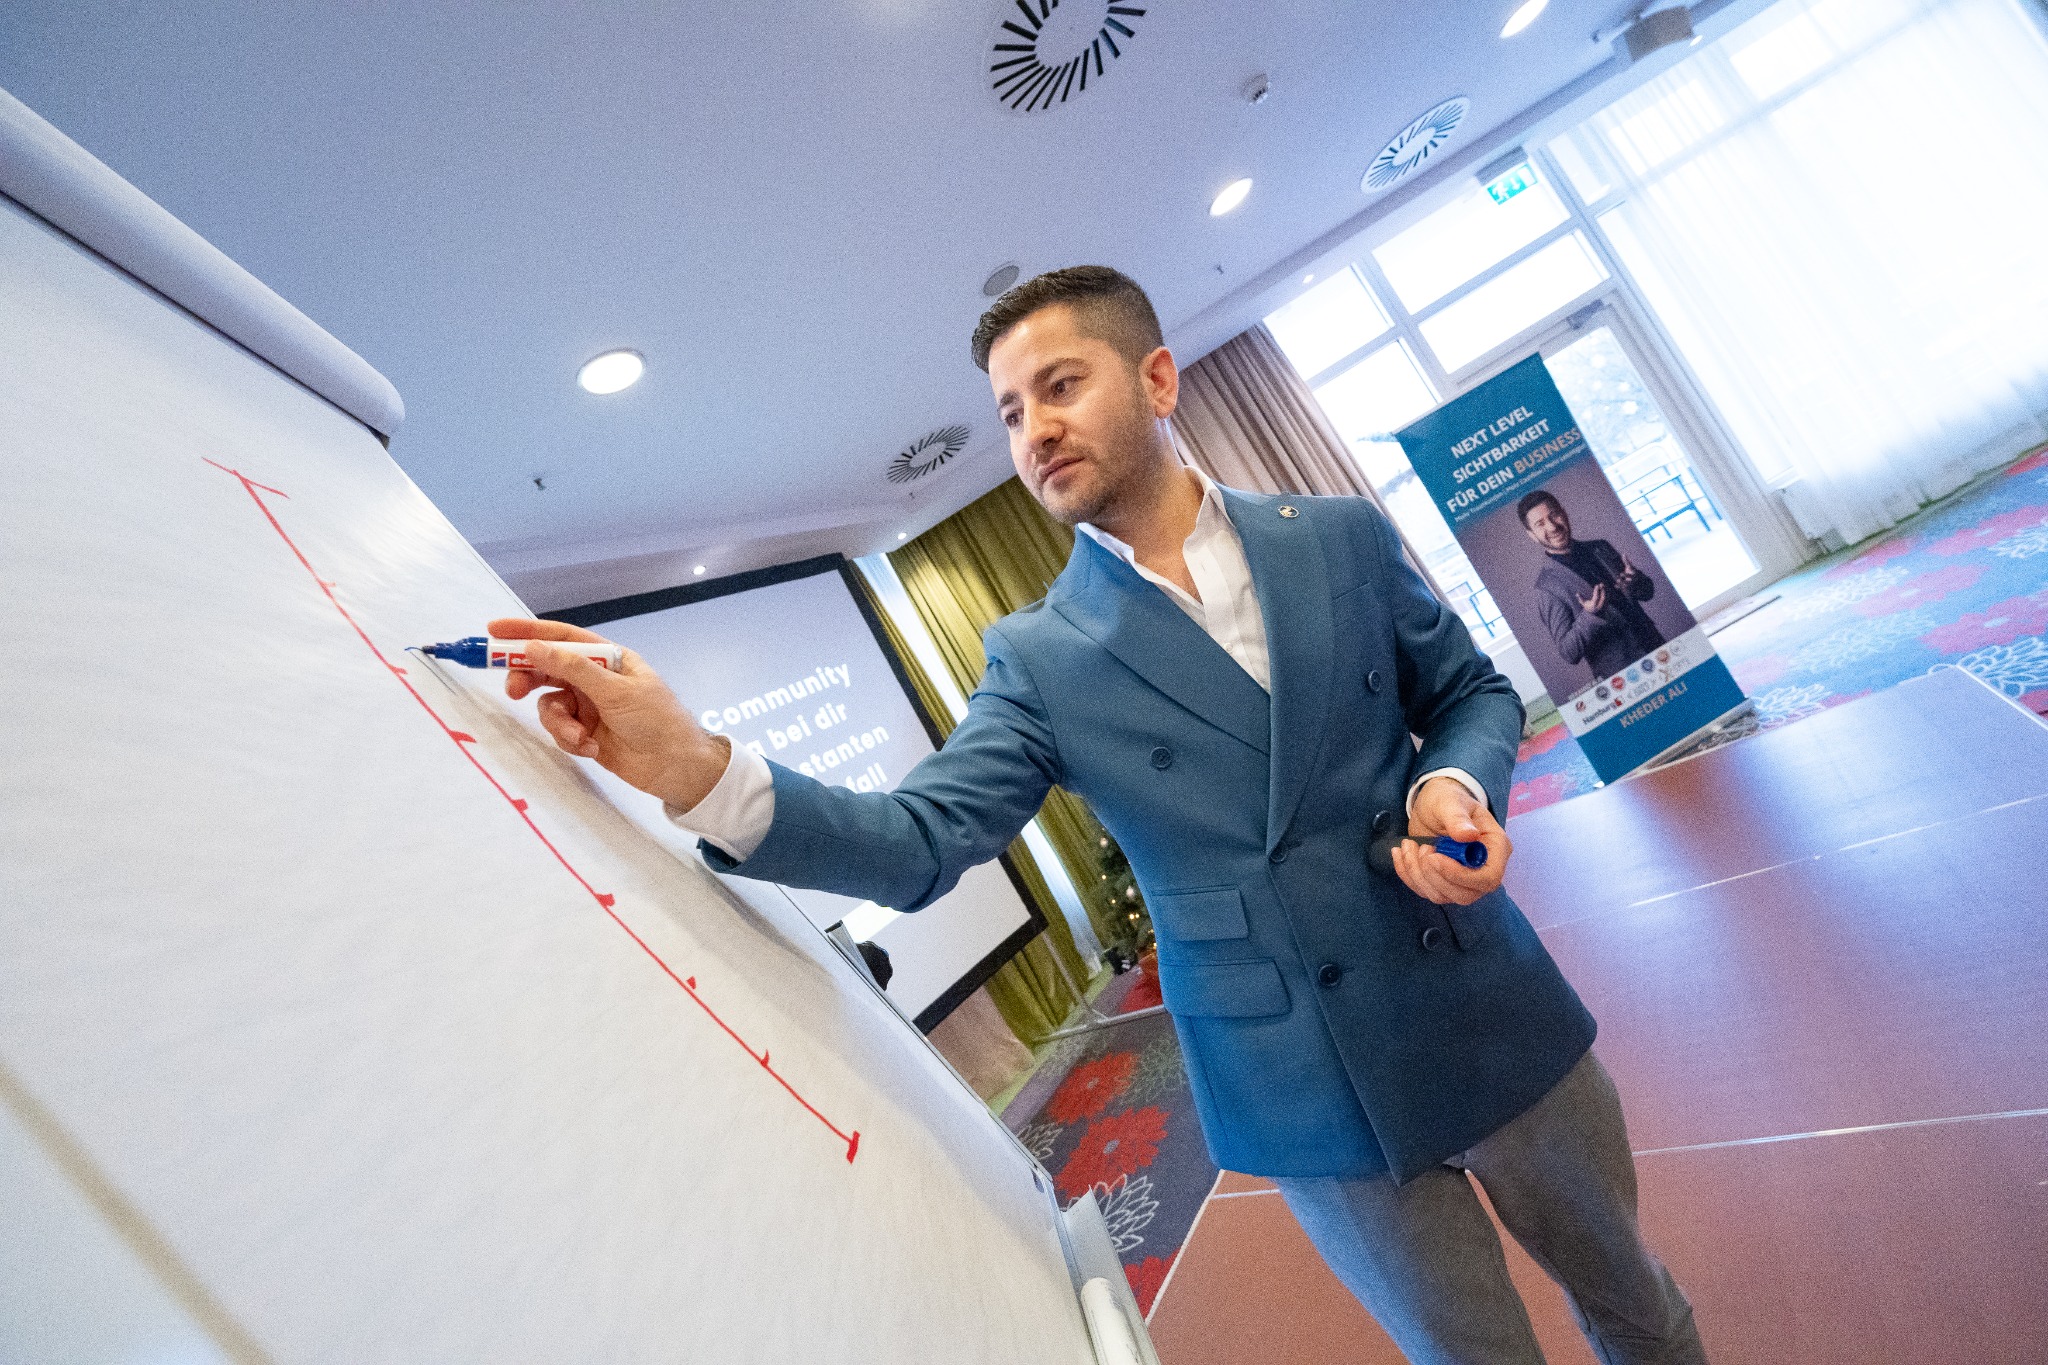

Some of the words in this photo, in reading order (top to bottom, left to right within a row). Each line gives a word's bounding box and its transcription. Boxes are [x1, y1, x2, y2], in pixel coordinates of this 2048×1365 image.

[1451, 430, 1489, 458] NEXT
[1489, 406, 1533, 436] LEVEL
[1453, 419, 1550, 484] SICHTBARKEIT
[1447, 489, 1478, 513] FÜR
[1477, 466, 1515, 496] DEIN
[1514, 428, 1581, 473] BUSINESS
[701, 663, 851, 733] Community
[1620, 694, 1668, 728] KHEDER
[1667, 681, 1688, 701] ALI
[766, 714, 812, 751] bei
[814, 702, 848, 731] dir
[798, 726, 890, 779] stanten
